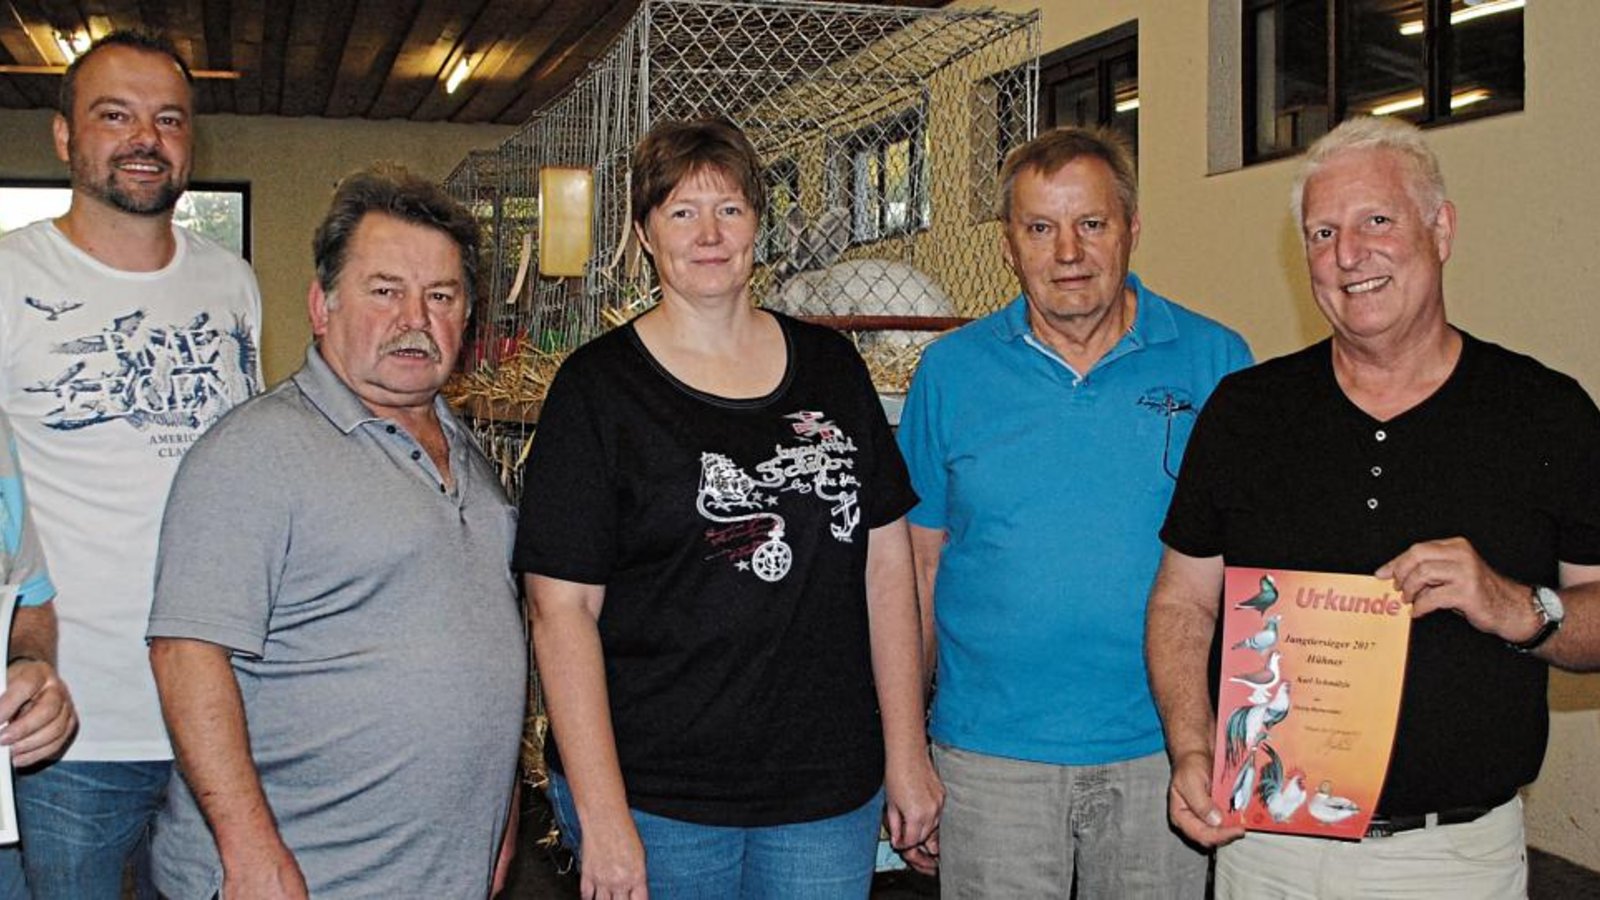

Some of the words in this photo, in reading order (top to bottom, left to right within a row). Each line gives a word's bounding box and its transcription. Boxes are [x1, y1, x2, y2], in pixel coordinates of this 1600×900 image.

[149, 433, 194, 442] AMERIC
[158, 445, 186, 457] CLA
[1296, 587, 1401, 616] Urkunde
[1352, 640, 1377, 650] 2017
[1306, 654, 1342, 666] Hühner
